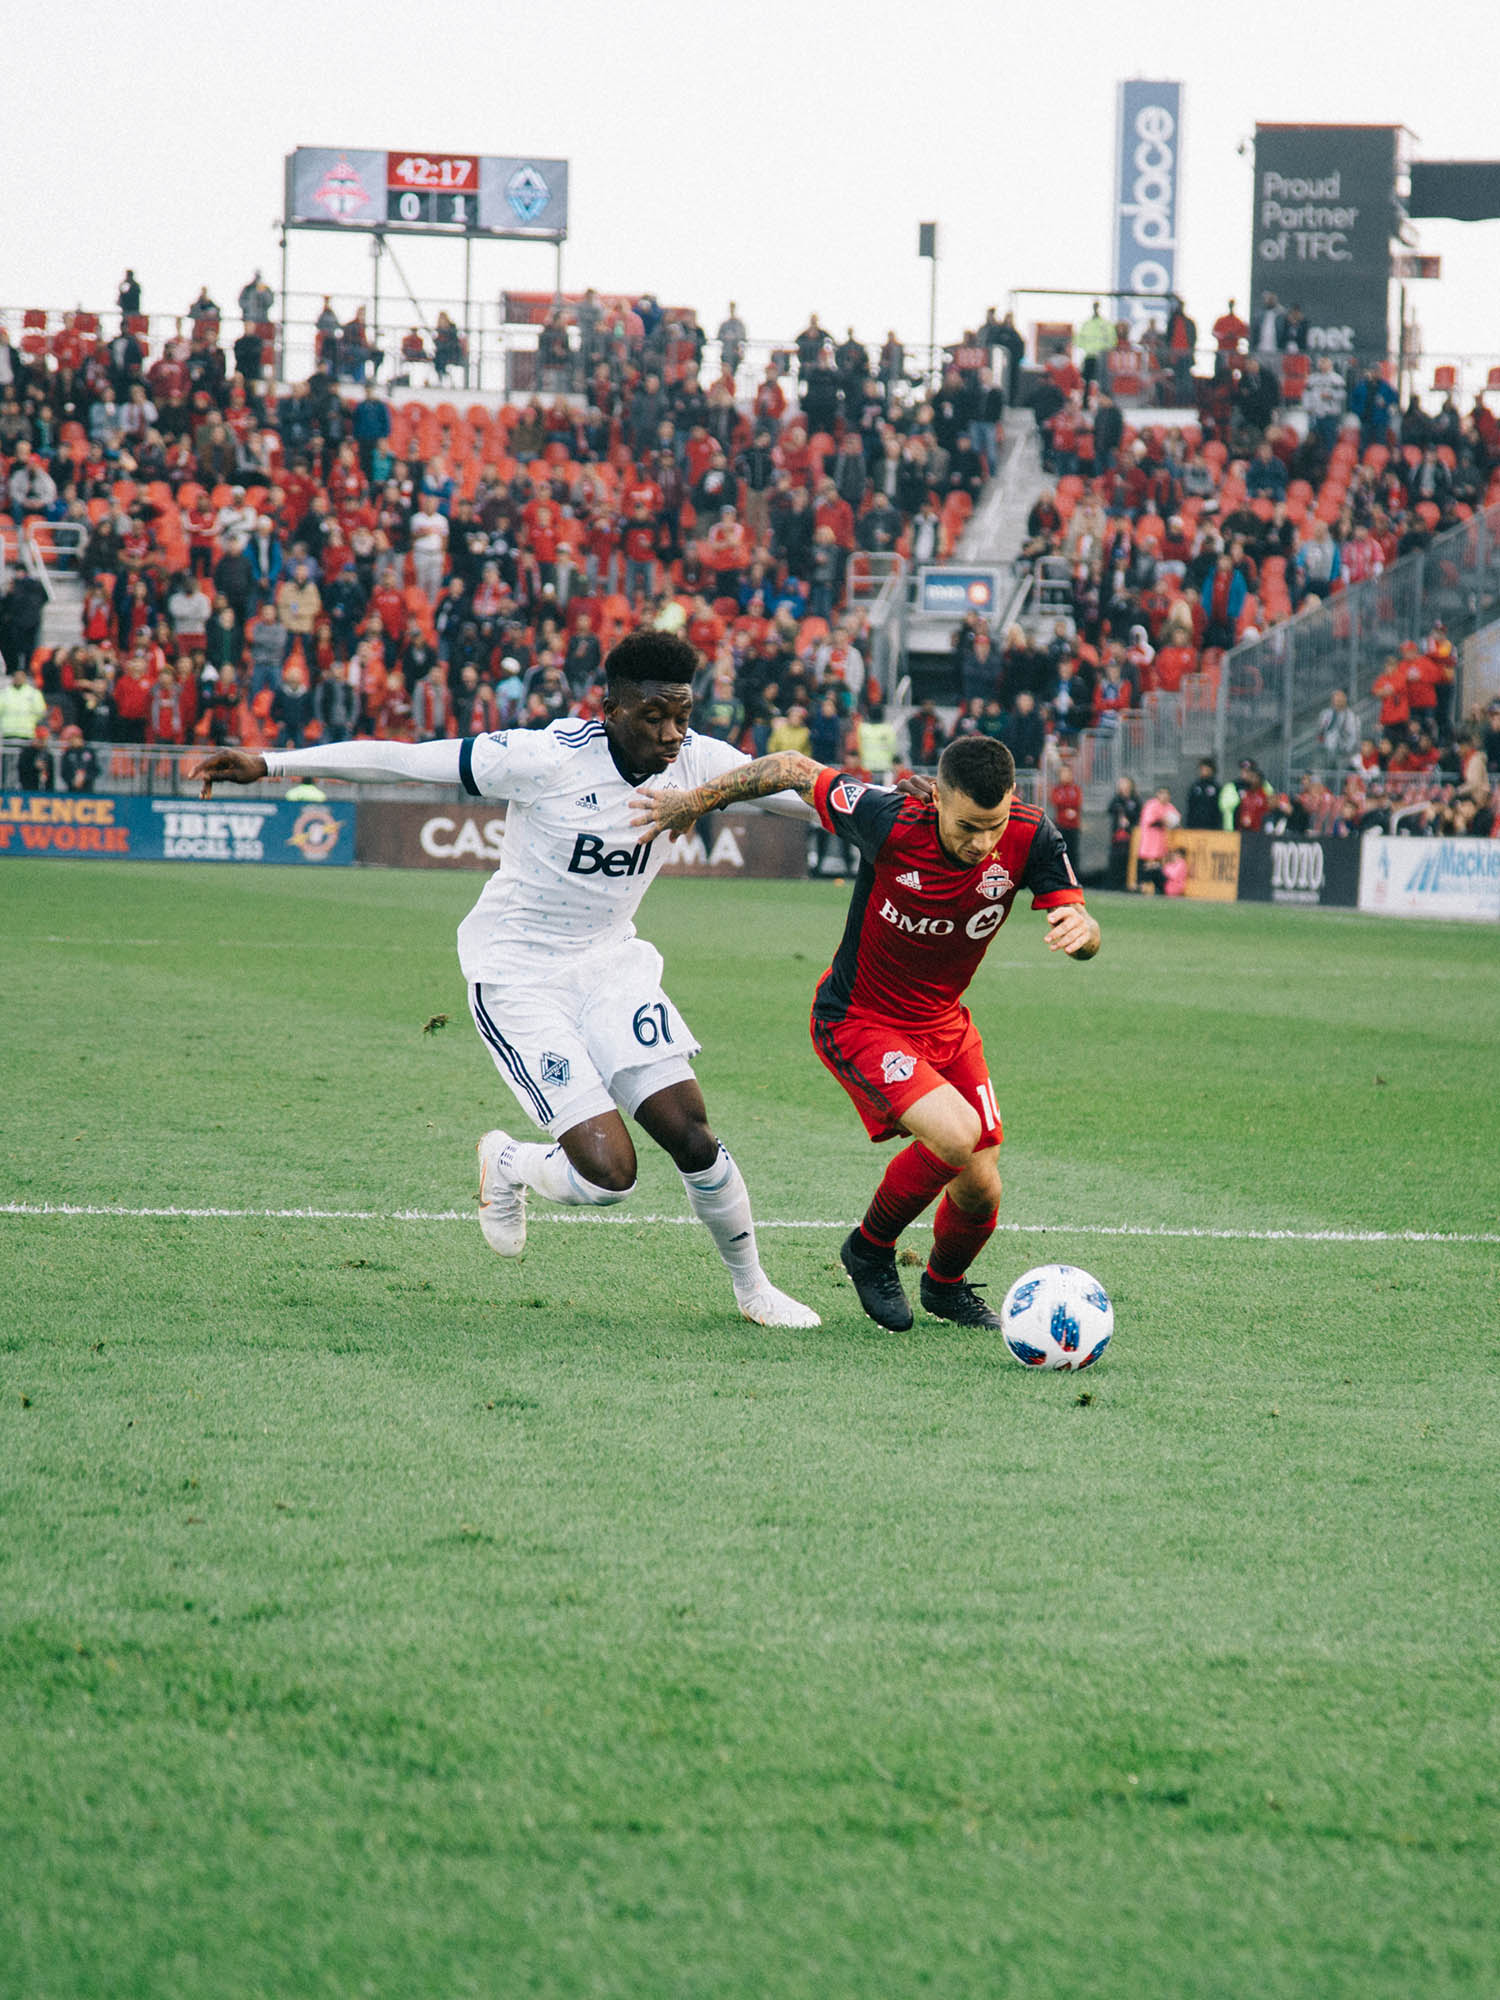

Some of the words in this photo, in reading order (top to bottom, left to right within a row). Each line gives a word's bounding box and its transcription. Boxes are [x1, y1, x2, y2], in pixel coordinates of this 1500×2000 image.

[397, 157, 472, 185] 42:17
[1119, 104, 1176, 250] place
[1264, 171, 1341, 200] Proud
[400, 192, 420, 221] 0
[452, 194, 468, 222] 1
[1263, 201, 1359, 229] Partner
[1260, 231, 1288, 260] of
[1306, 326, 1356, 350] net
[575, 799, 601, 812] adidas
[20, 825, 130, 852] WORK
[419, 816, 506, 859] CAS
[672, 826, 745, 867] MA
[567, 832, 654, 877] Bell
[895, 875, 922, 891] adidas
[879, 899, 954, 936] BMO
[632, 1002, 674, 1047] 61
